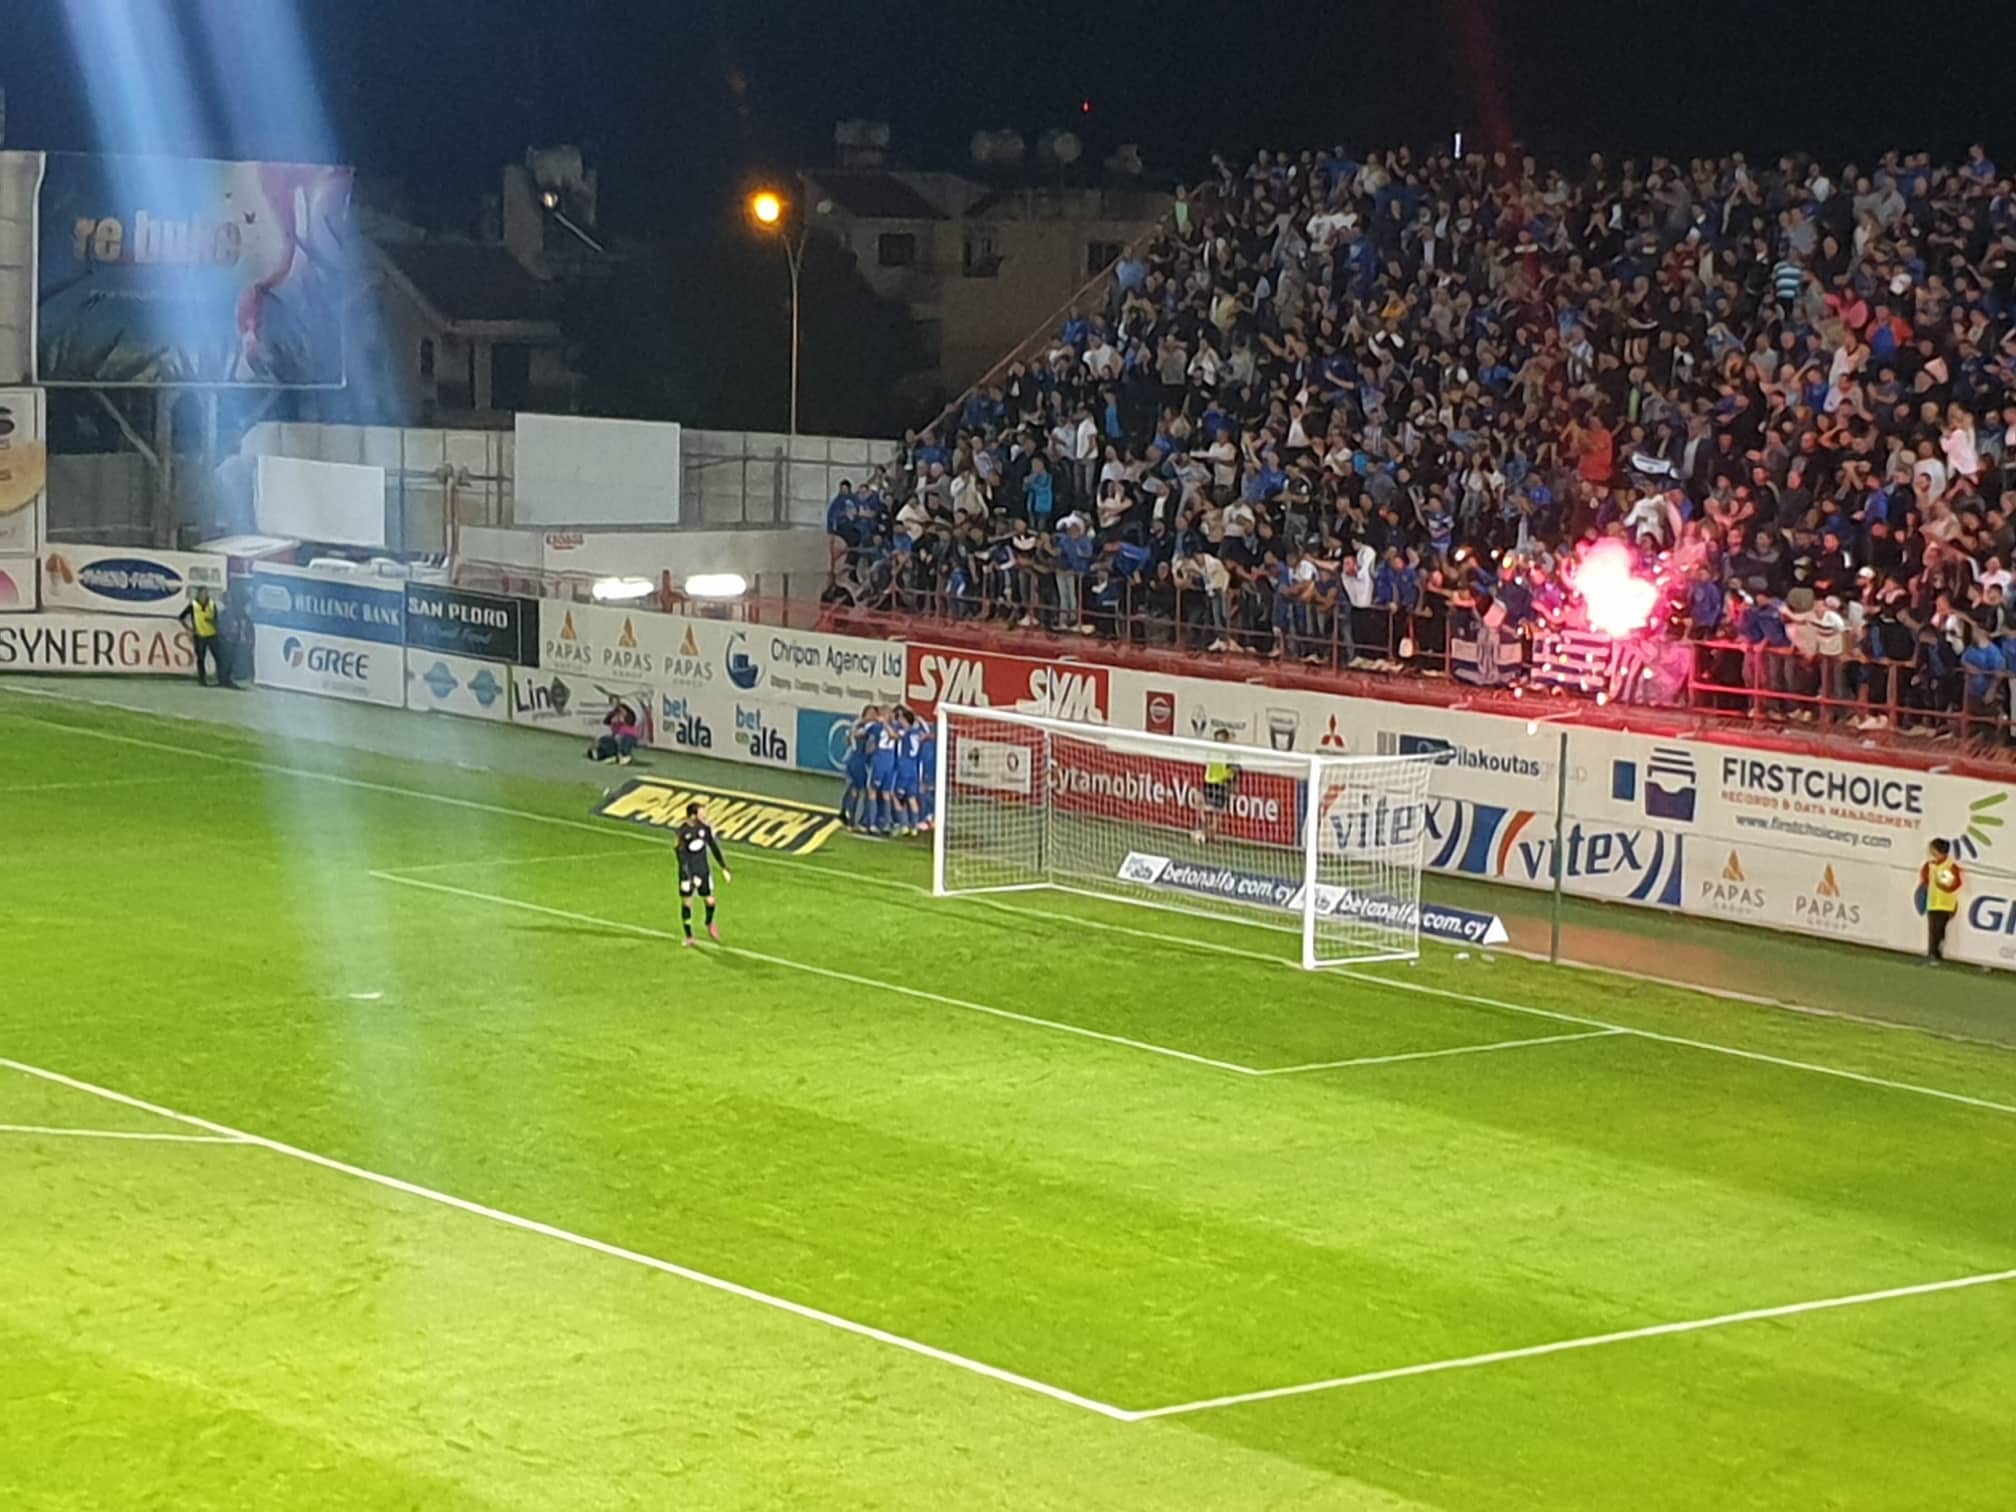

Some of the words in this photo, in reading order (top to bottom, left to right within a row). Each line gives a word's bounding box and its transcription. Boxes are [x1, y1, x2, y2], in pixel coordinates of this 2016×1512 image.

[294, 594, 358, 622] HELLENIC
[362, 603, 400, 626] BANK
[408, 597, 443, 618] SAN
[0, 627, 196, 667] SYNERGAS
[307, 646, 370, 681] GREE
[546, 641, 592, 665] PAPAS
[604, 648, 652, 672] PAPAS
[826, 645, 877, 679] Agency
[882, 651, 902, 677] Ltd
[664, 656, 713, 681] PAPAS
[908, 655, 990, 706] SYM
[662, 692, 688, 719] bet
[1016, 667, 1103, 723] SYM
[676, 714, 712, 748] alfa
[736, 703, 761, 730] bet
[750, 726, 787, 762] alfa
[1722, 757, 1924, 814] FIRSTCHOICE
[1330, 794, 1442, 849] vitex
[1721, 790, 1779, 810] RECORDS
[1794, 801, 1826, 816] DATA
[1830, 808, 1921, 830] MANAGEMENT
[1518, 824, 1642, 880] vitex
[1702, 881, 1765, 909] PAPAS
[1795, 896, 1860, 924] PAPAS
